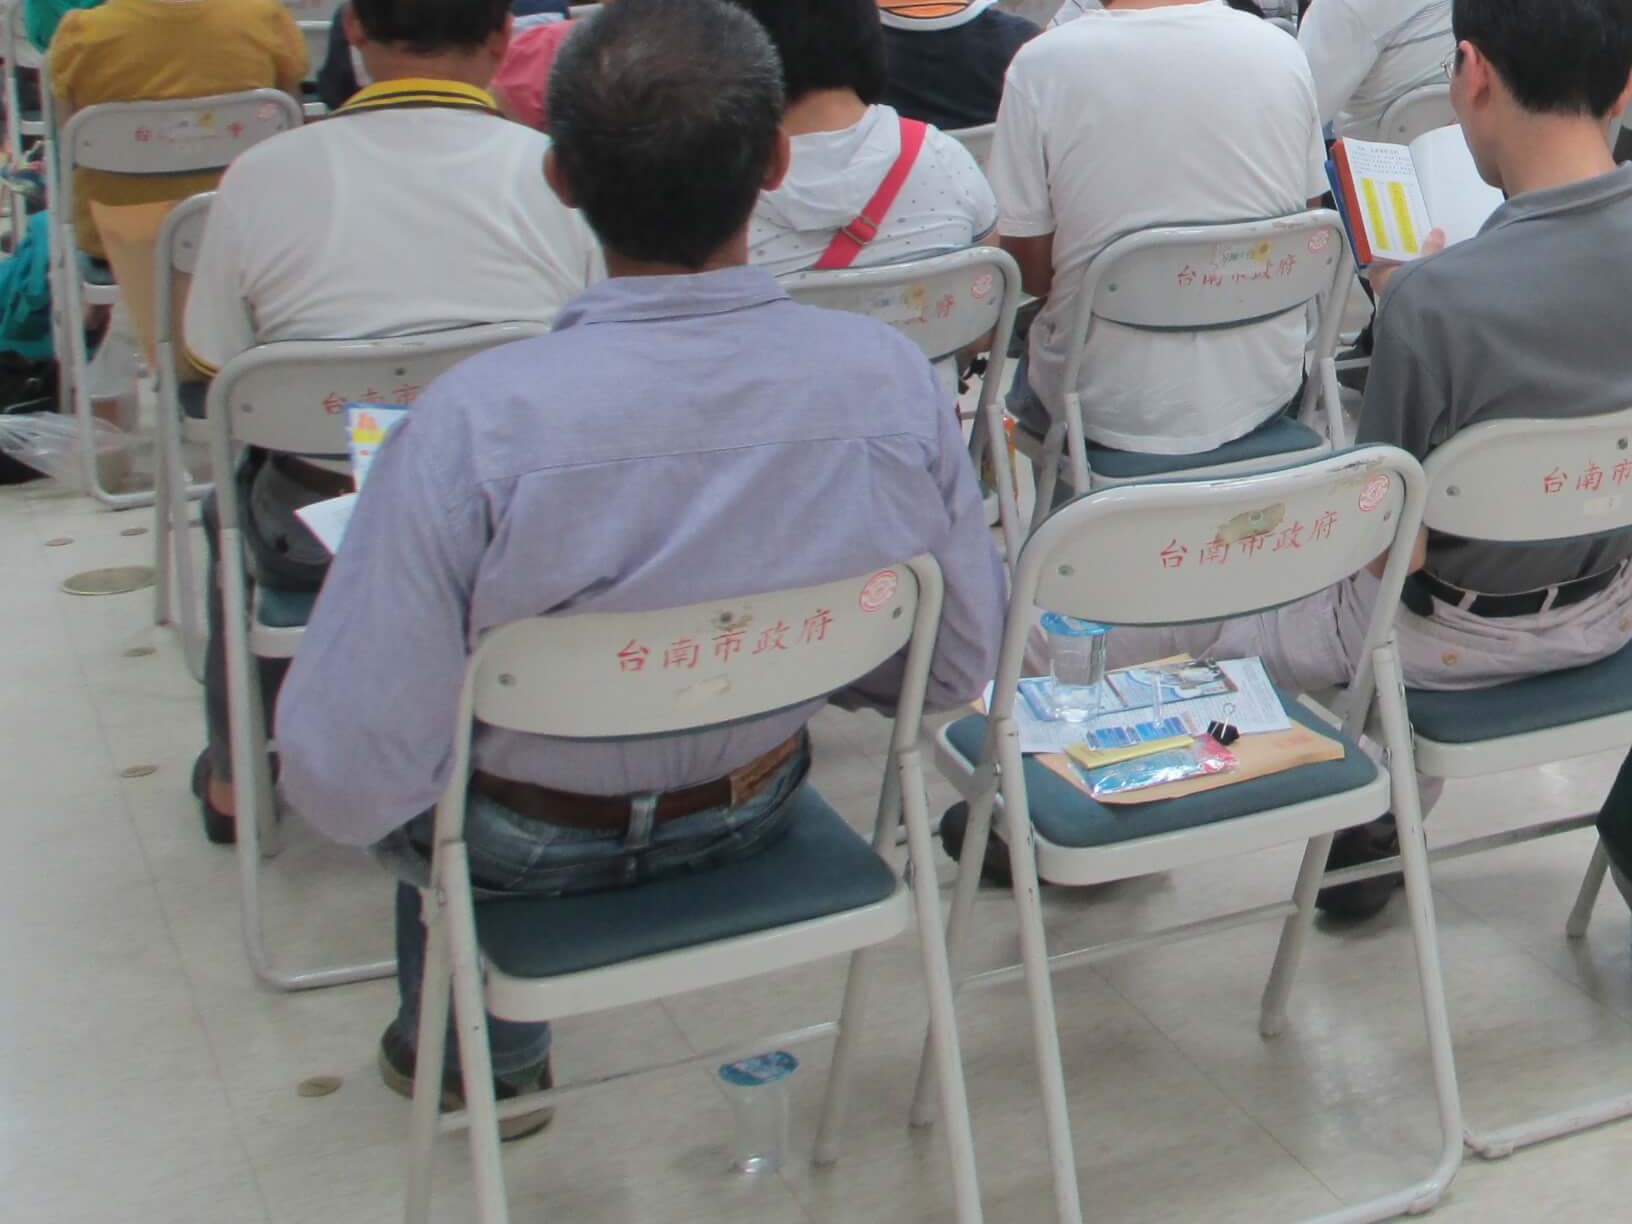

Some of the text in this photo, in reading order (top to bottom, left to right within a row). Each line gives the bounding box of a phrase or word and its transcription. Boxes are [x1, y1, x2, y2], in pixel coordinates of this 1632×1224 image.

[1160, 510, 1339, 569] 台南市政府
[616, 608, 834, 673] 台南市政府
